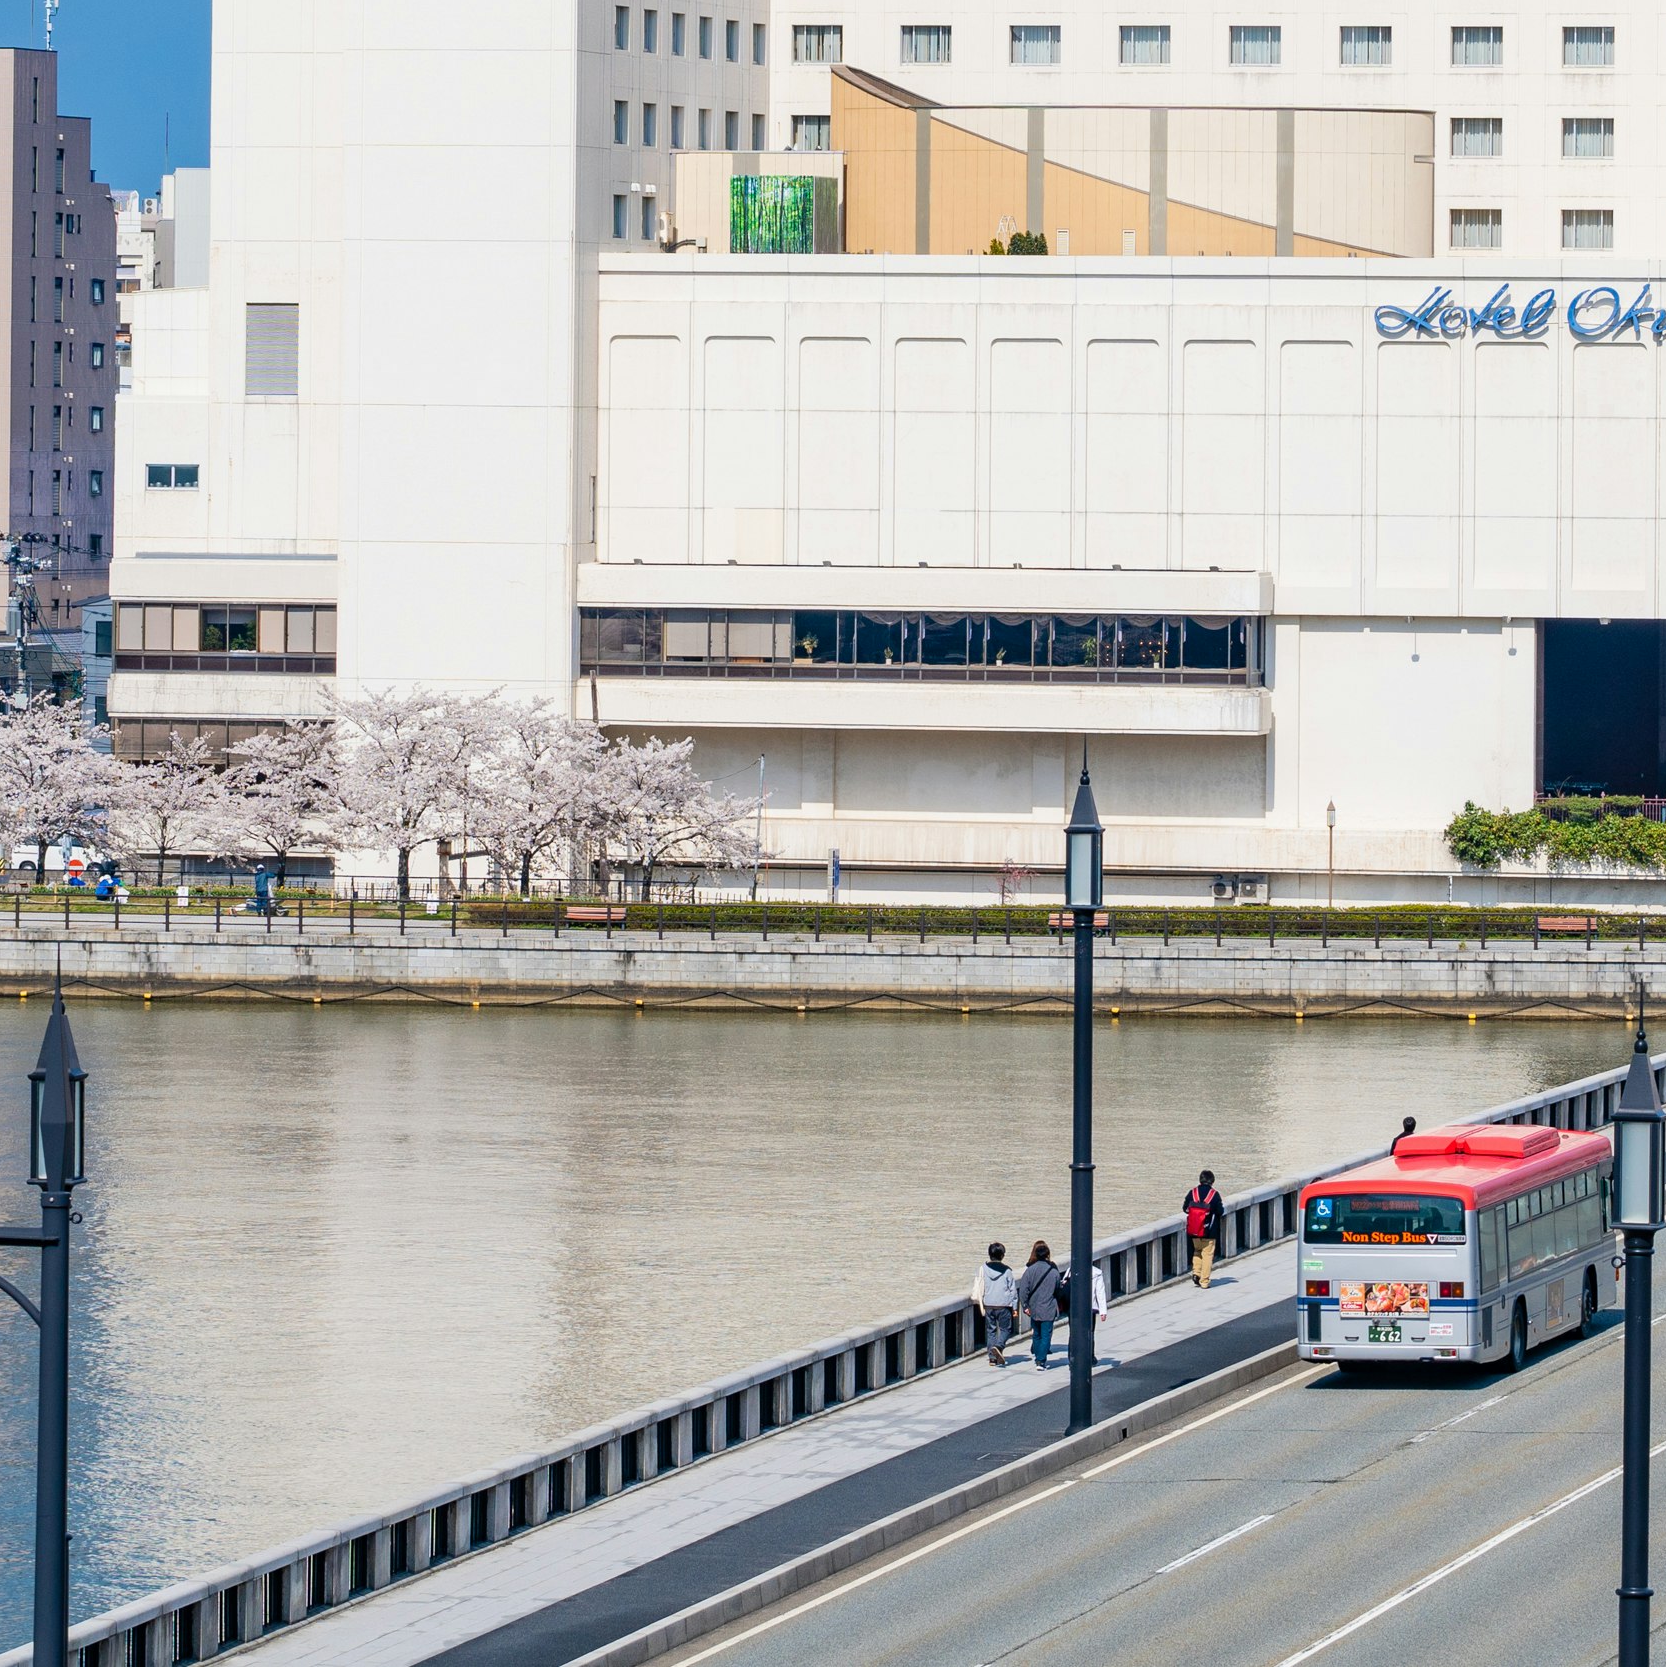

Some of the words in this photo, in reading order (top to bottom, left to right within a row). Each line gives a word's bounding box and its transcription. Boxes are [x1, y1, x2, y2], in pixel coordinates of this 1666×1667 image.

[1374, 282, 1555, 333] Hotel
[1342, 1231, 1368, 1242] Non
[1371, 1232, 1400, 1244] Step
[1402, 1232, 1426, 1243] Bus
